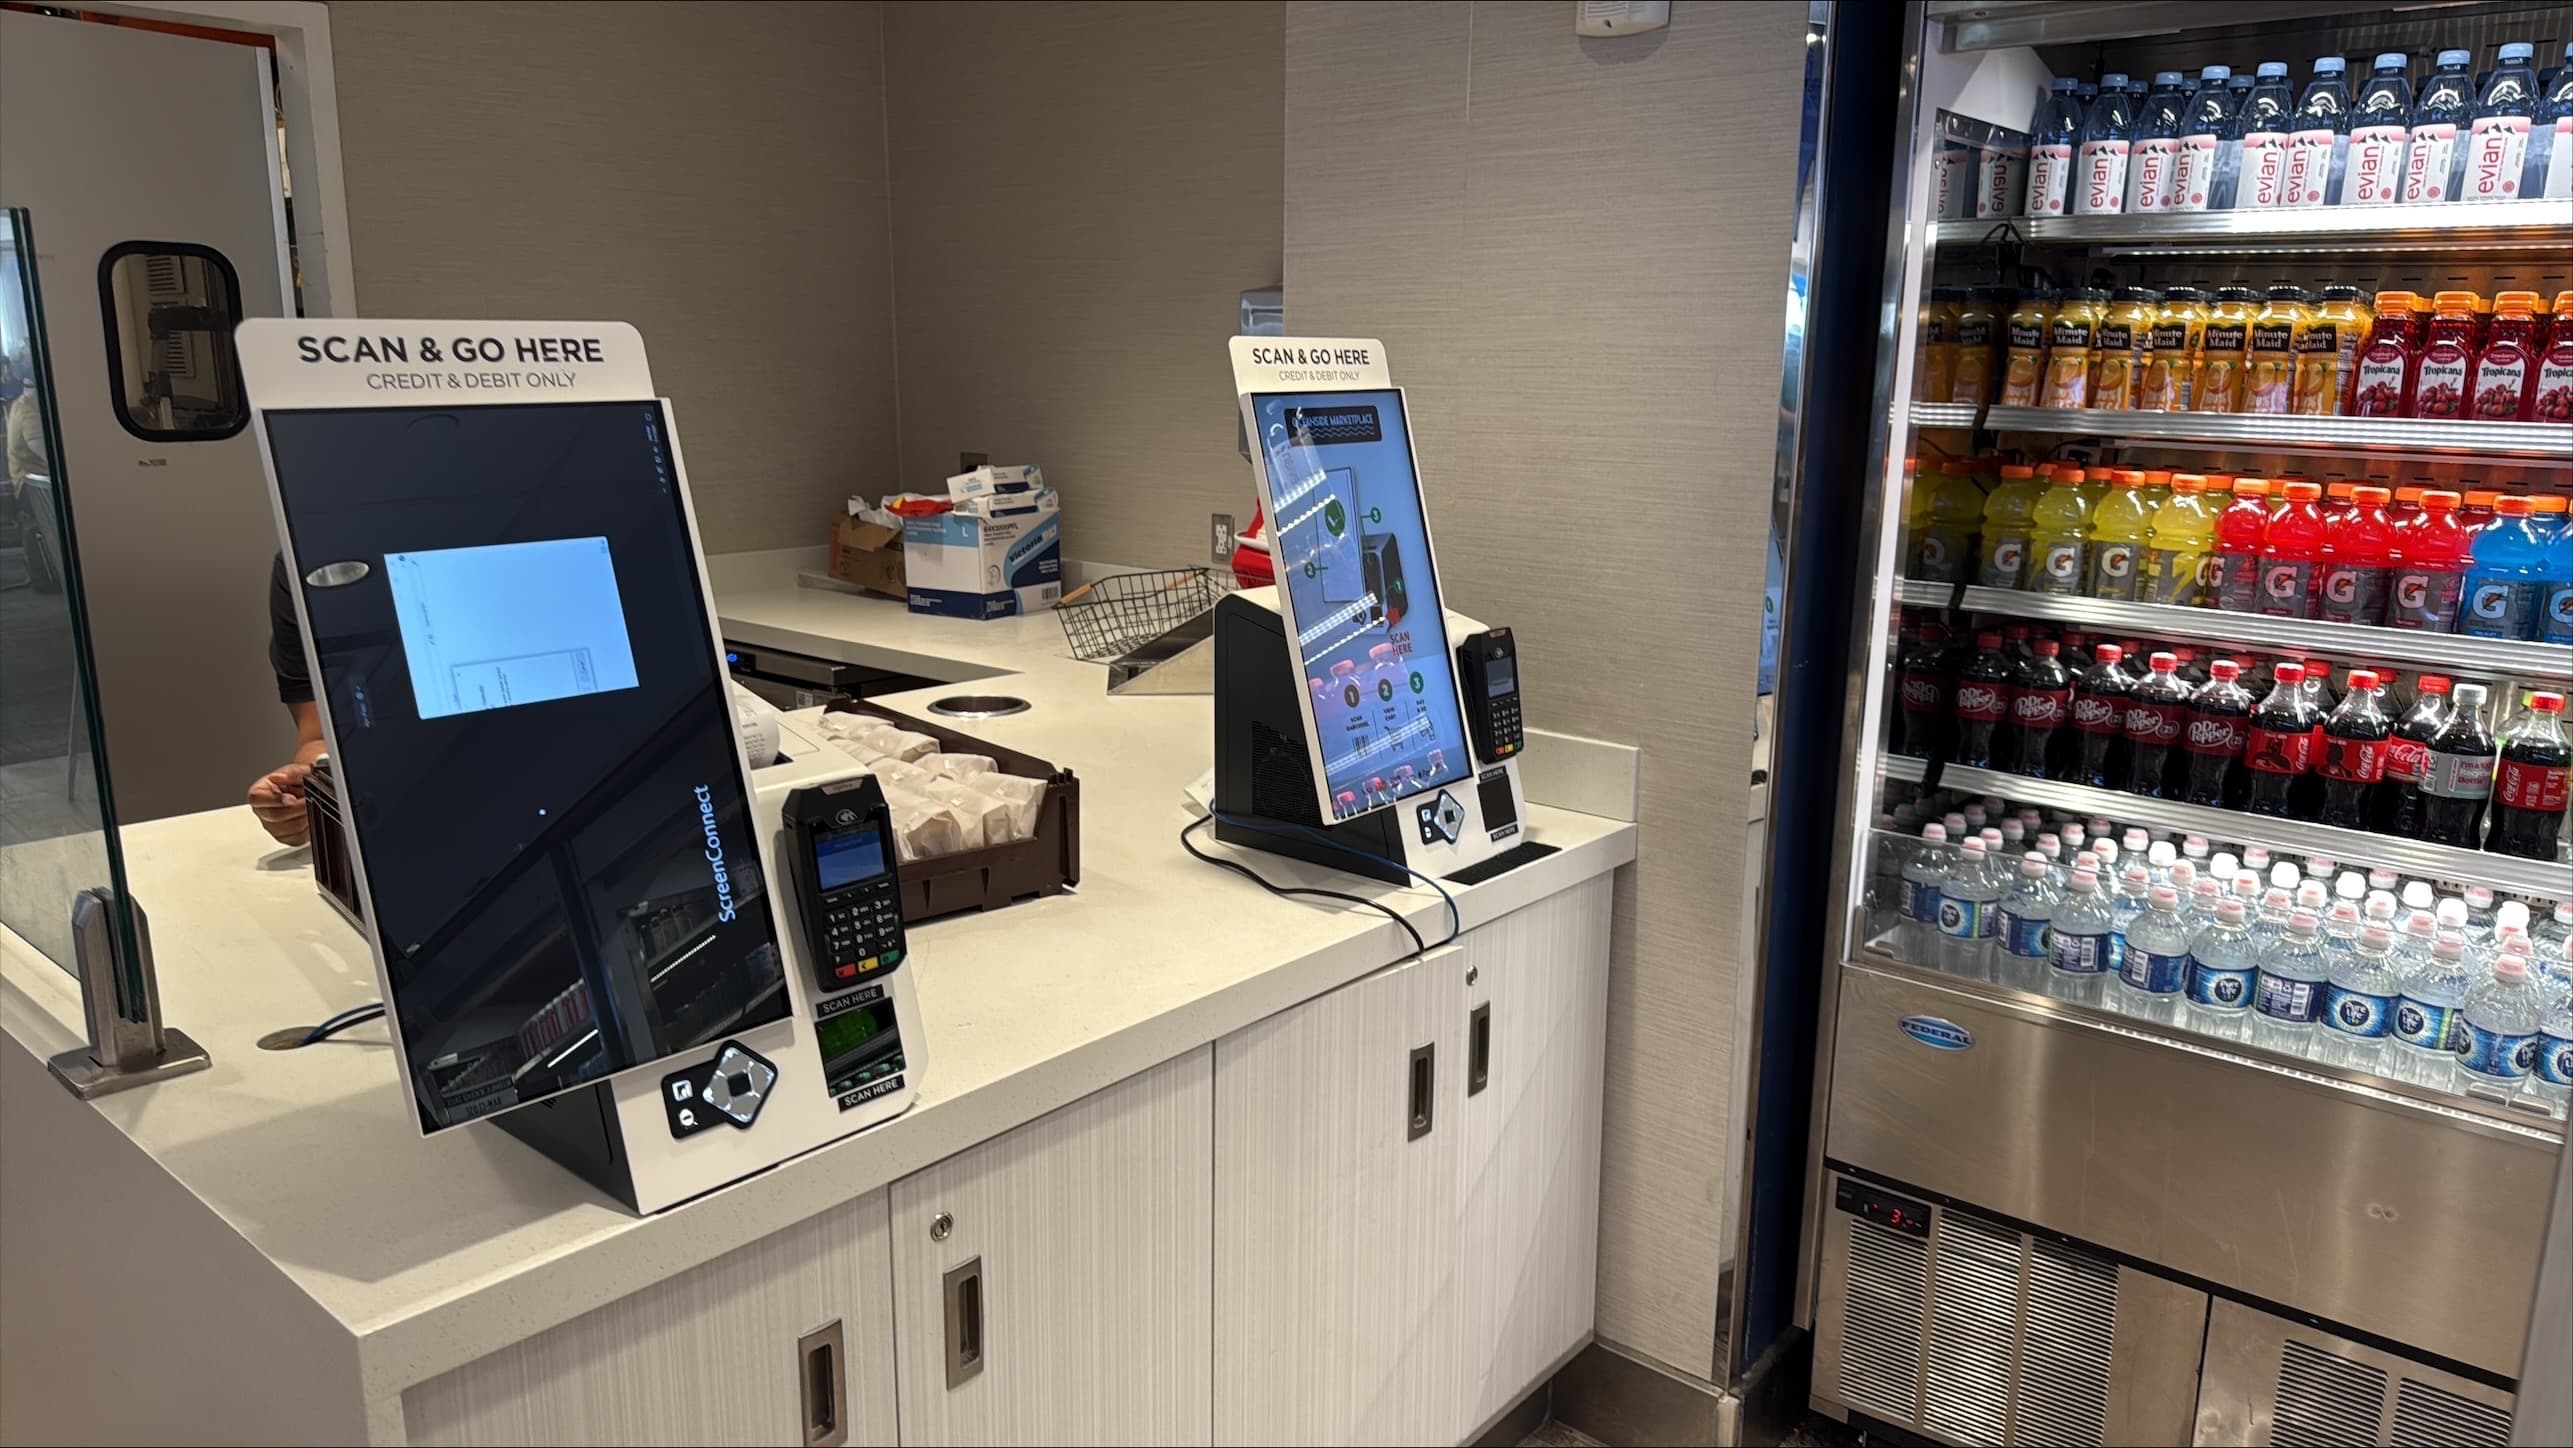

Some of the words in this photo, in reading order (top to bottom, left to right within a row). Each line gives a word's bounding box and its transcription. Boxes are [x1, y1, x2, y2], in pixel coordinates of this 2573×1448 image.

[2288, 150, 2306, 204] evian
[2358, 145, 2380, 200] evian
[2407, 144, 2427, 200] evian
[2478, 137, 2503, 193] evian
[2032, 162, 2048, 211] evian
[2089, 158, 2108, 208] evian
[2140, 156, 2159, 207] evian
[2174, 153, 2190, 205] evian
[2257, 152, 2278, 204] evian
[2013, 336, 2036, 346] Maid
[2053, 327, 2088, 337] Minute
[2056, 336, 2082, 345] Maid
[2207, 328, 2243, 339] Minute
[2209, 338, 2237, 347] Maid
[2254, 328, 2288, 339] Minute
[2256, 338, 2281, 347] Maid
[298, 336, 408, 363] SCAN
[419, 336, 444, 362] &
[452, 337, 505, 362] GO
[514, 338, 604, 362] HERE
[1252, 348, 1294, 365] SCAN
[1298, 348, 1307, 364] &
[1310, 348, 1331, 365] GO
[1334, 349, 1370, 365] HERE
[367, 373, 442, 390] CREDIT
[448, 373, 462, 389] &
[464, 372, 521, 389] DEBIT
[526, 372, 576, 388] ONLY
[1279, 370, 1308, 382] CREDIT
[1309, 370, 1315, 381] &
[1316, 370, 1338, 381] DEBIT
[1340, 371, 1360, 381] ONLY
[2363, 365, 2400, 376] Tropicana
[2424, 365, 2464, 376] Tropicana
[2482, 367, 2521, 378] Tropicana
[2544, 367, 2573, 379] Tropica
[1009, 535, 1042, 562] Victoria
[1994, 543, 2021, 572] G
[2047, 547, 2075, 577] G
[2102, 547, 2131, 577] G
[2265, 566, 2297, 598] G
[2326, 571, 2357, 603] G
[2398, 575, 2429, 609] G
[2473, 585, 2509, 620] G
[1390, 631, 1410, 645] SCAN
[1392, 643, 1413, 656] HERE
[1381, 684, 1390, 697] 2
[1413, 677, 1421, 689] 3
[2017, 697, 2054, 717] Pepper
[2126, 710, 2160, 731] Pepper
[2191, 722, 2230, 743] Pepper
[694, 784, 736, 922] ScreenConnect
[823, 997, 850, 1014] SCAN
[852, 988, 878, 1004] HERE
[1901, 1020, 1970, 1044] FEDERAL
[845, 1089, 871, 1106] SCAN
[873, 1079, 898, 1094] HERE
[1891, 1208, 1901, 1224] 3
